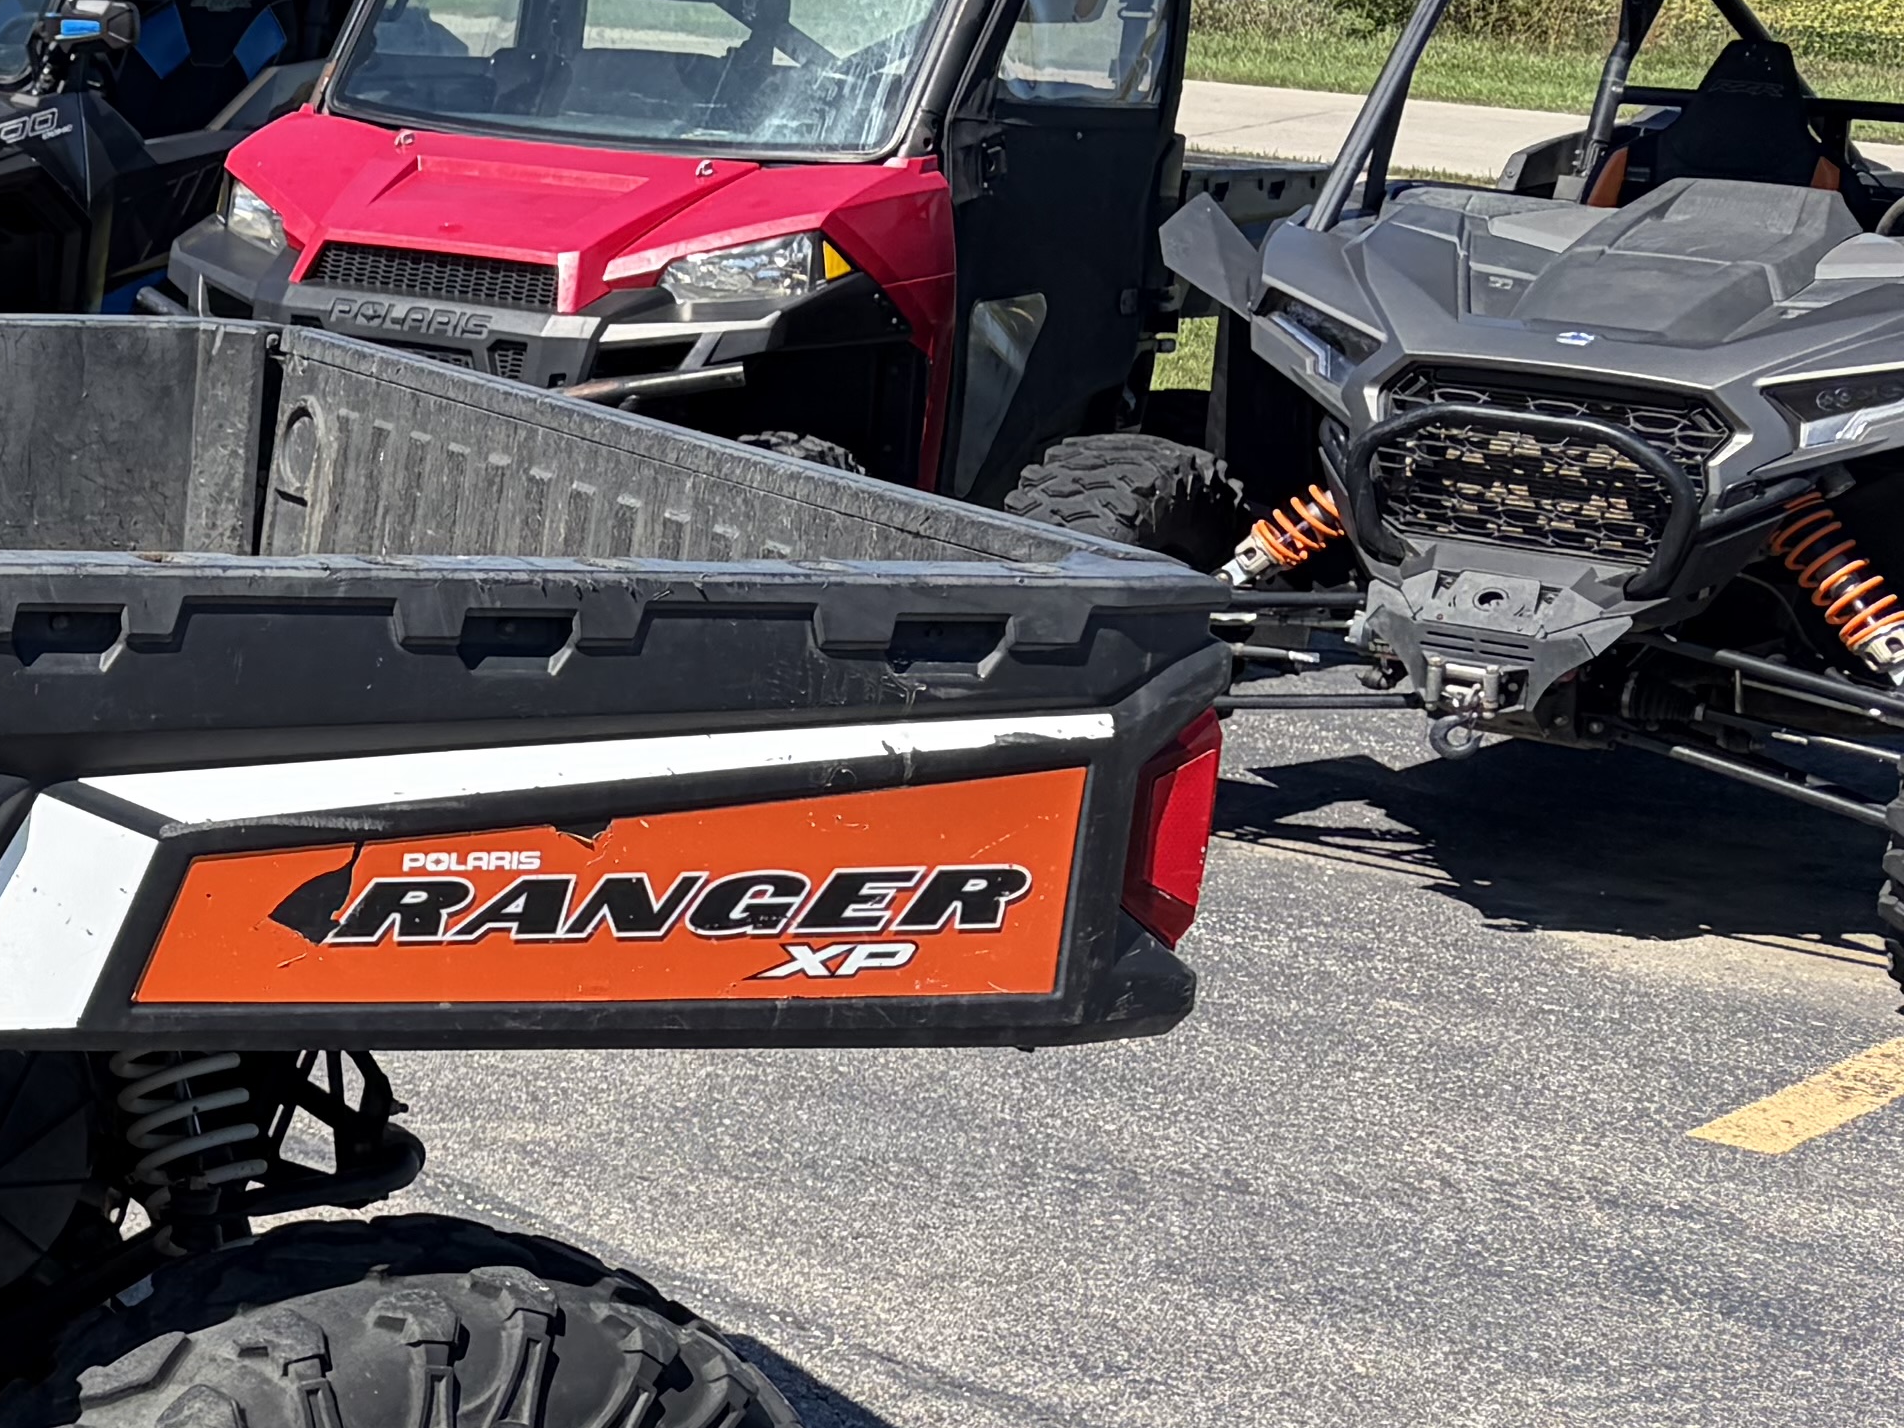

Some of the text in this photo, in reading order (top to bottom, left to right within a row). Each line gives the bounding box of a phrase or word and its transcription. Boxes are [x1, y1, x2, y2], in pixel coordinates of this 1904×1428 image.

[329, 296, 493, 341] POLARIS
[402, 850, 542, 872] POLARIS
[326, 864, 1033, 943] RANGER
[744, 940, 919, 981] XP
